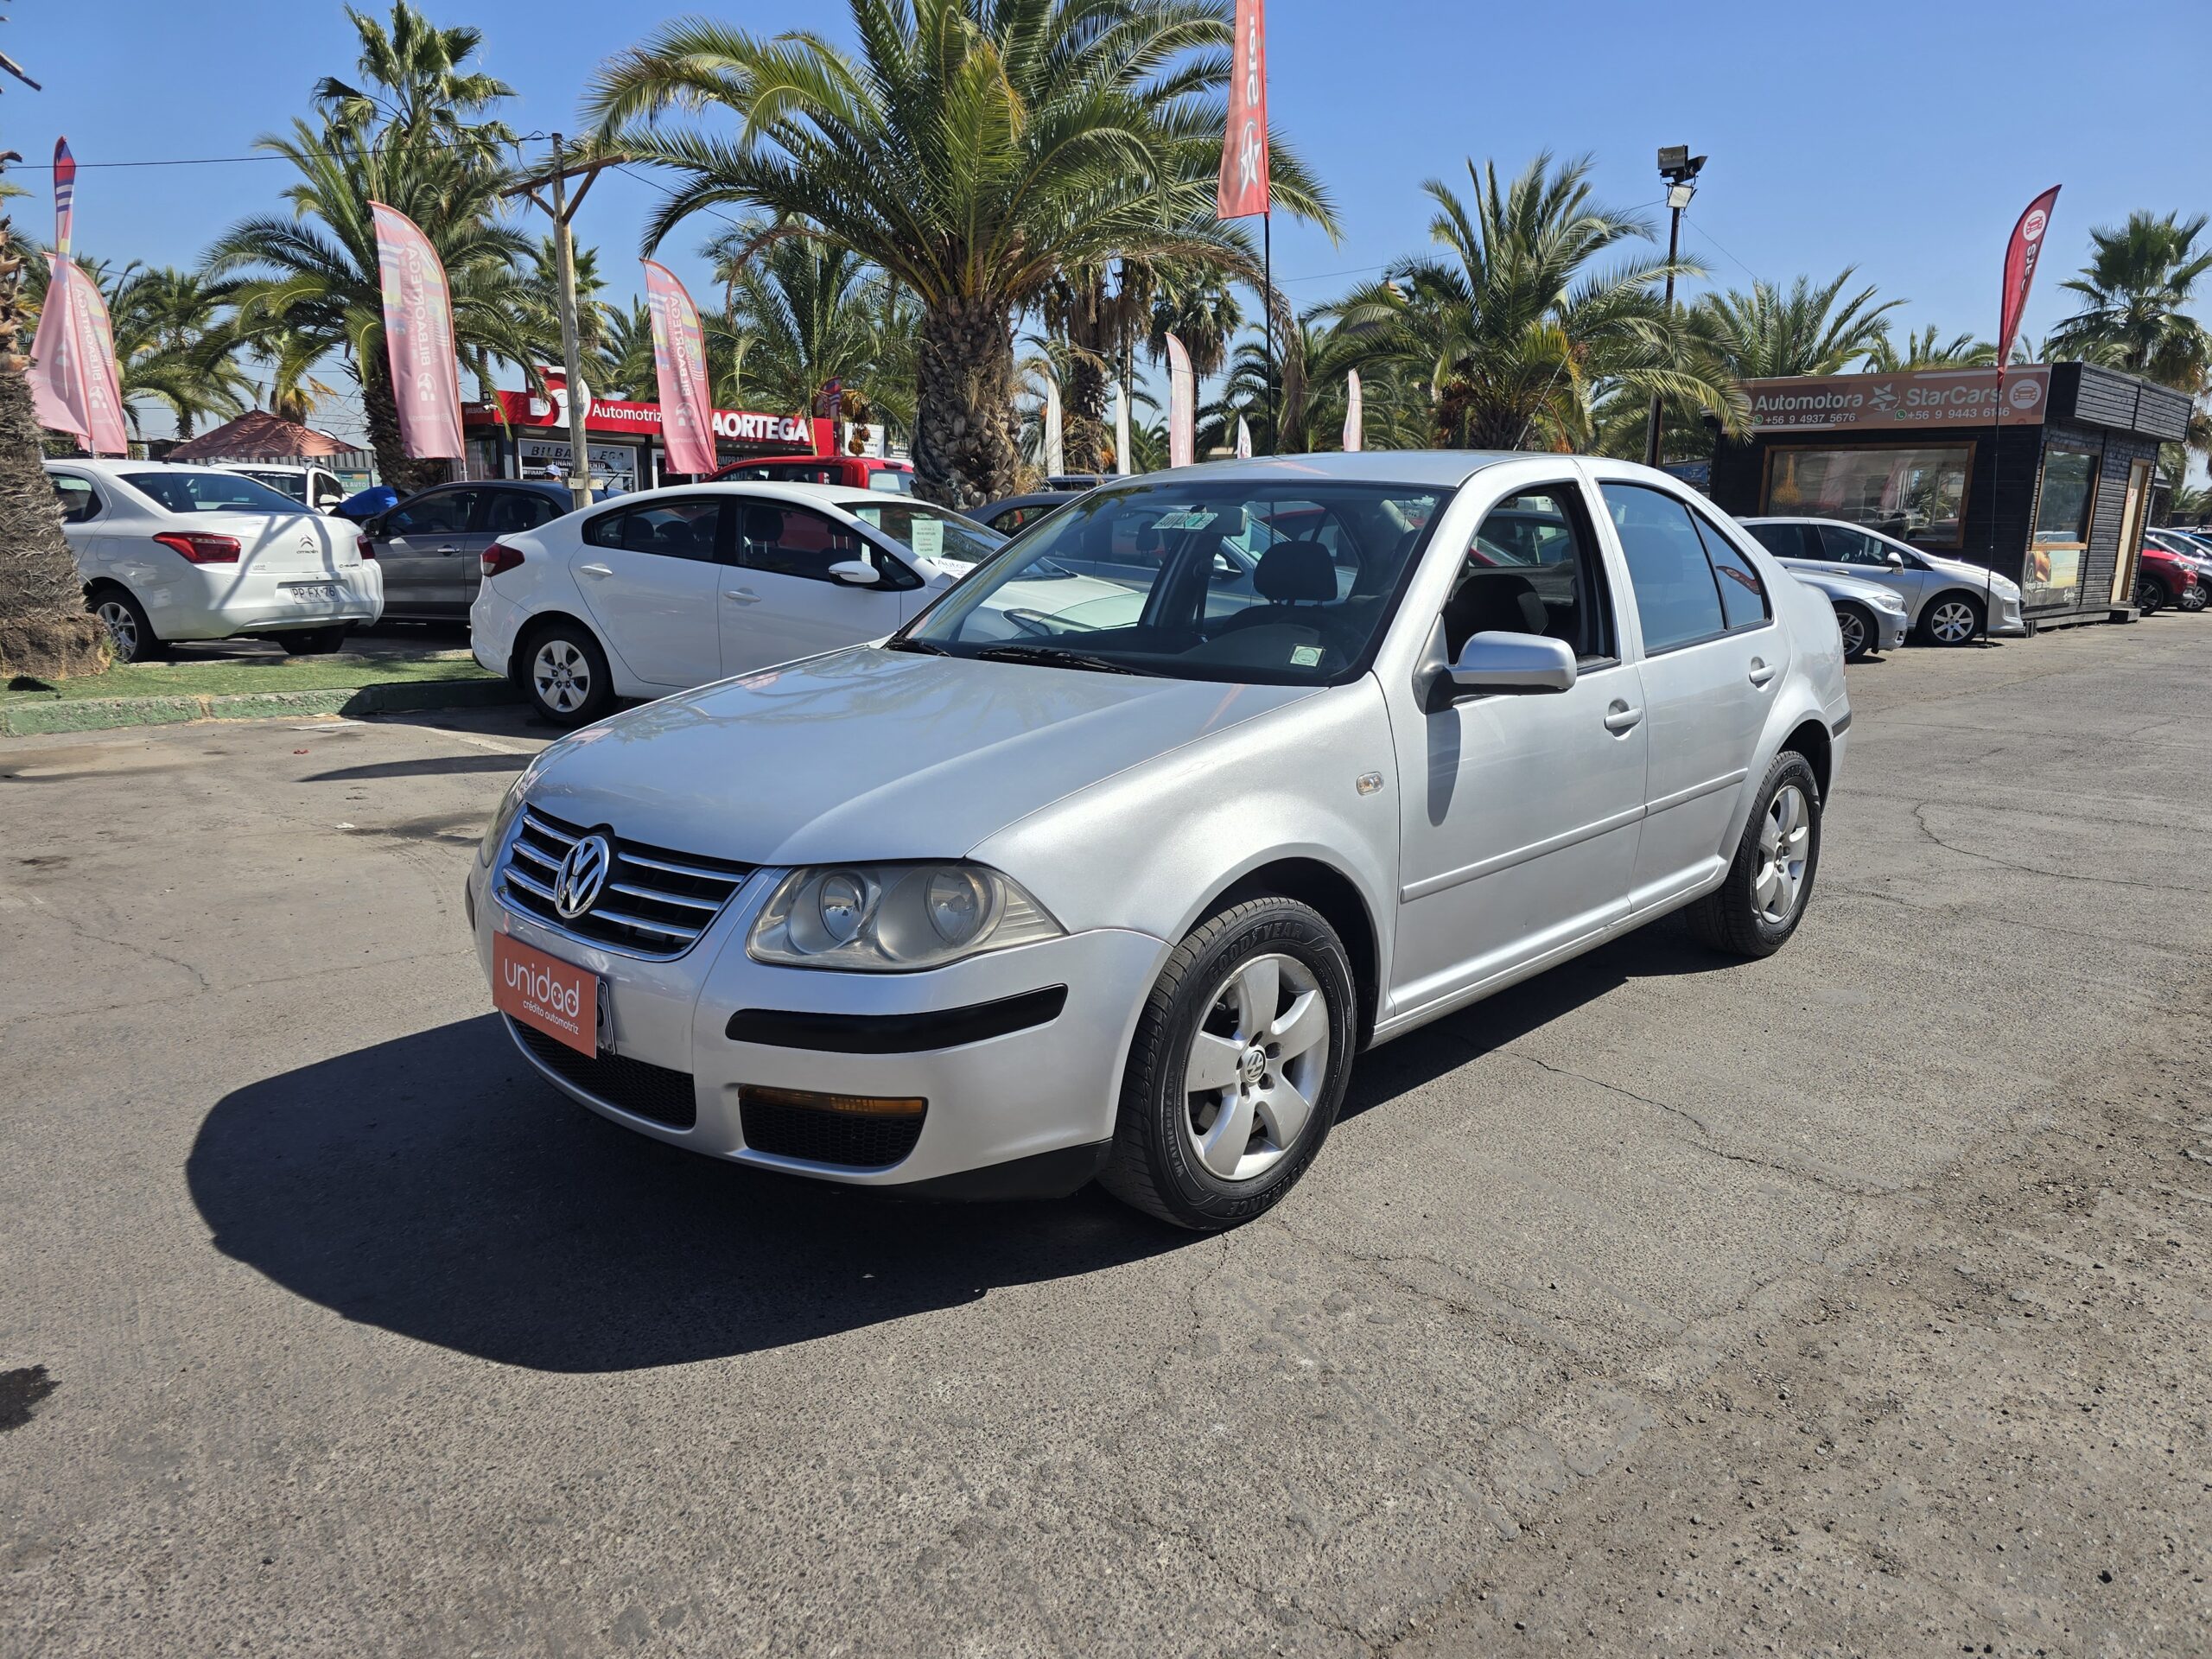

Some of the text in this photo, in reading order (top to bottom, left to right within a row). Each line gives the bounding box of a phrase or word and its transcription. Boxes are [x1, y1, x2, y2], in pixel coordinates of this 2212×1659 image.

[1755, 385, 2004, 411] Automotora StarCars
[592, 404, 662, 423] Automotriz
[1765, 412, 1856, 425] +56 9 4937 5676
[1907, 410, 1929, 421] +56
[1935, 409, 1942, 420] 9
[1948, 408, 1977, 419] 9443
[505, 957, 580, 1018] unidad
[523, 999, 580, 1035] crédito automotriz
